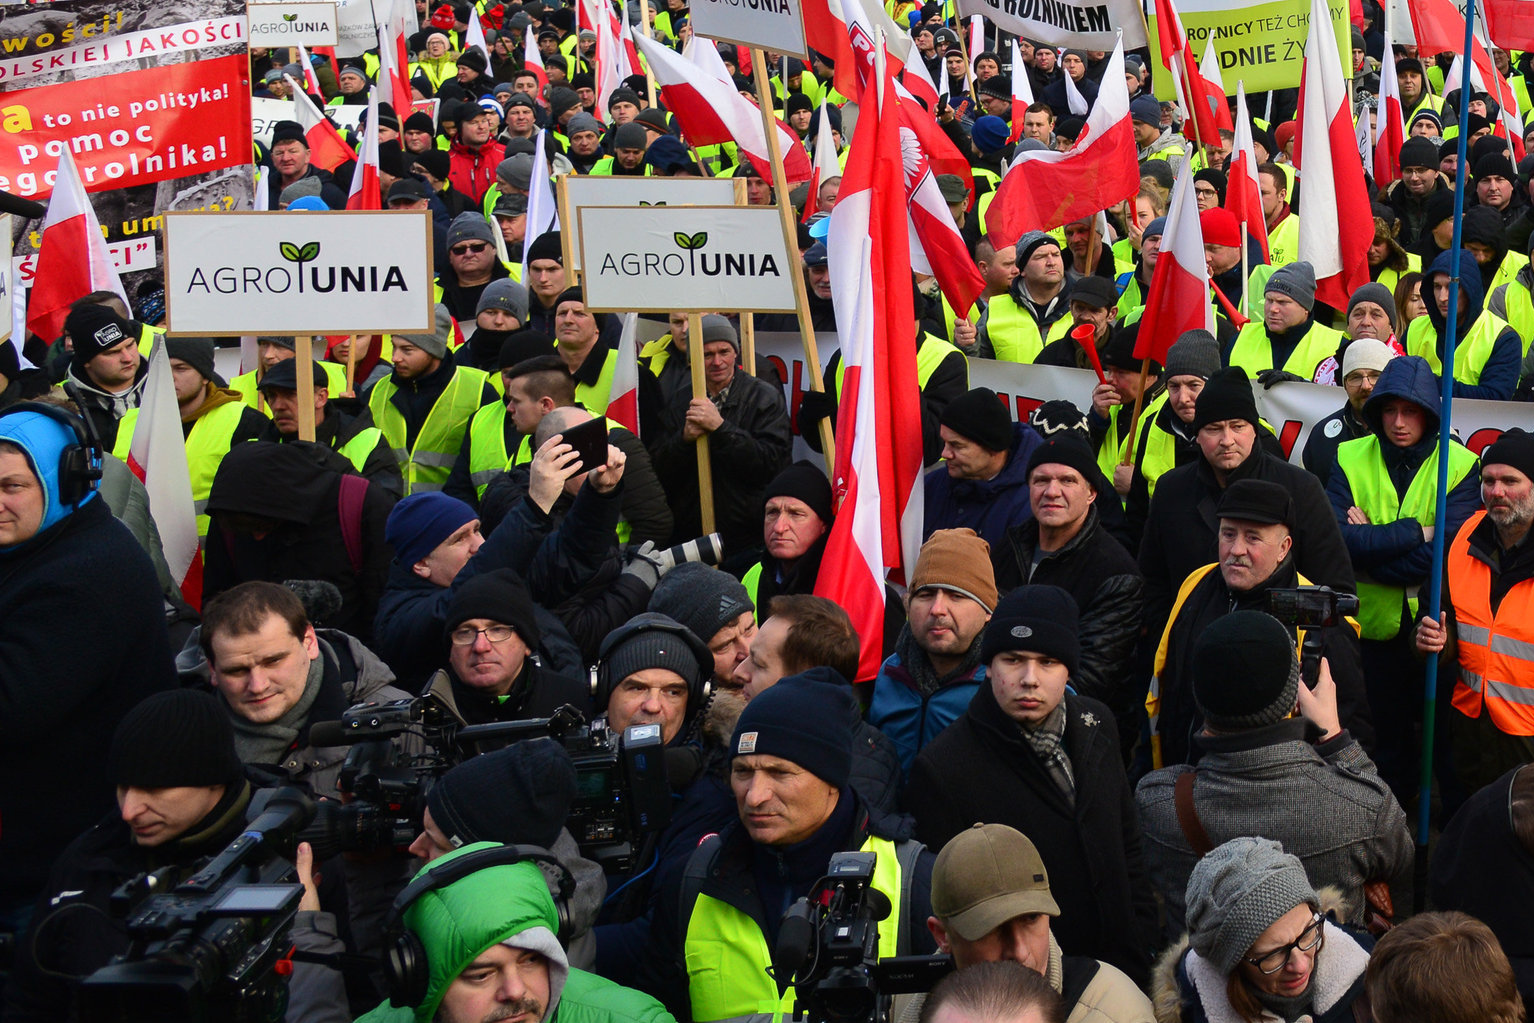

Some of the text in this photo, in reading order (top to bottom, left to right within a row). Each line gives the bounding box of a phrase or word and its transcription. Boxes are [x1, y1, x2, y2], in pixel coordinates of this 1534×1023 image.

[126, 21, 241, 57] JAKOŚCI
[1256, 14, 1284, 33] TEŻ
[1193, 44, 1276, 70] DNIE
[44, 113, 72, 128] to
[82, 104, 120, 122] nie
[129, 83, 229, 118] polityka!
[18, 124, 153, 165] pomoc
[84, 136, 228, 183] rolnika!
